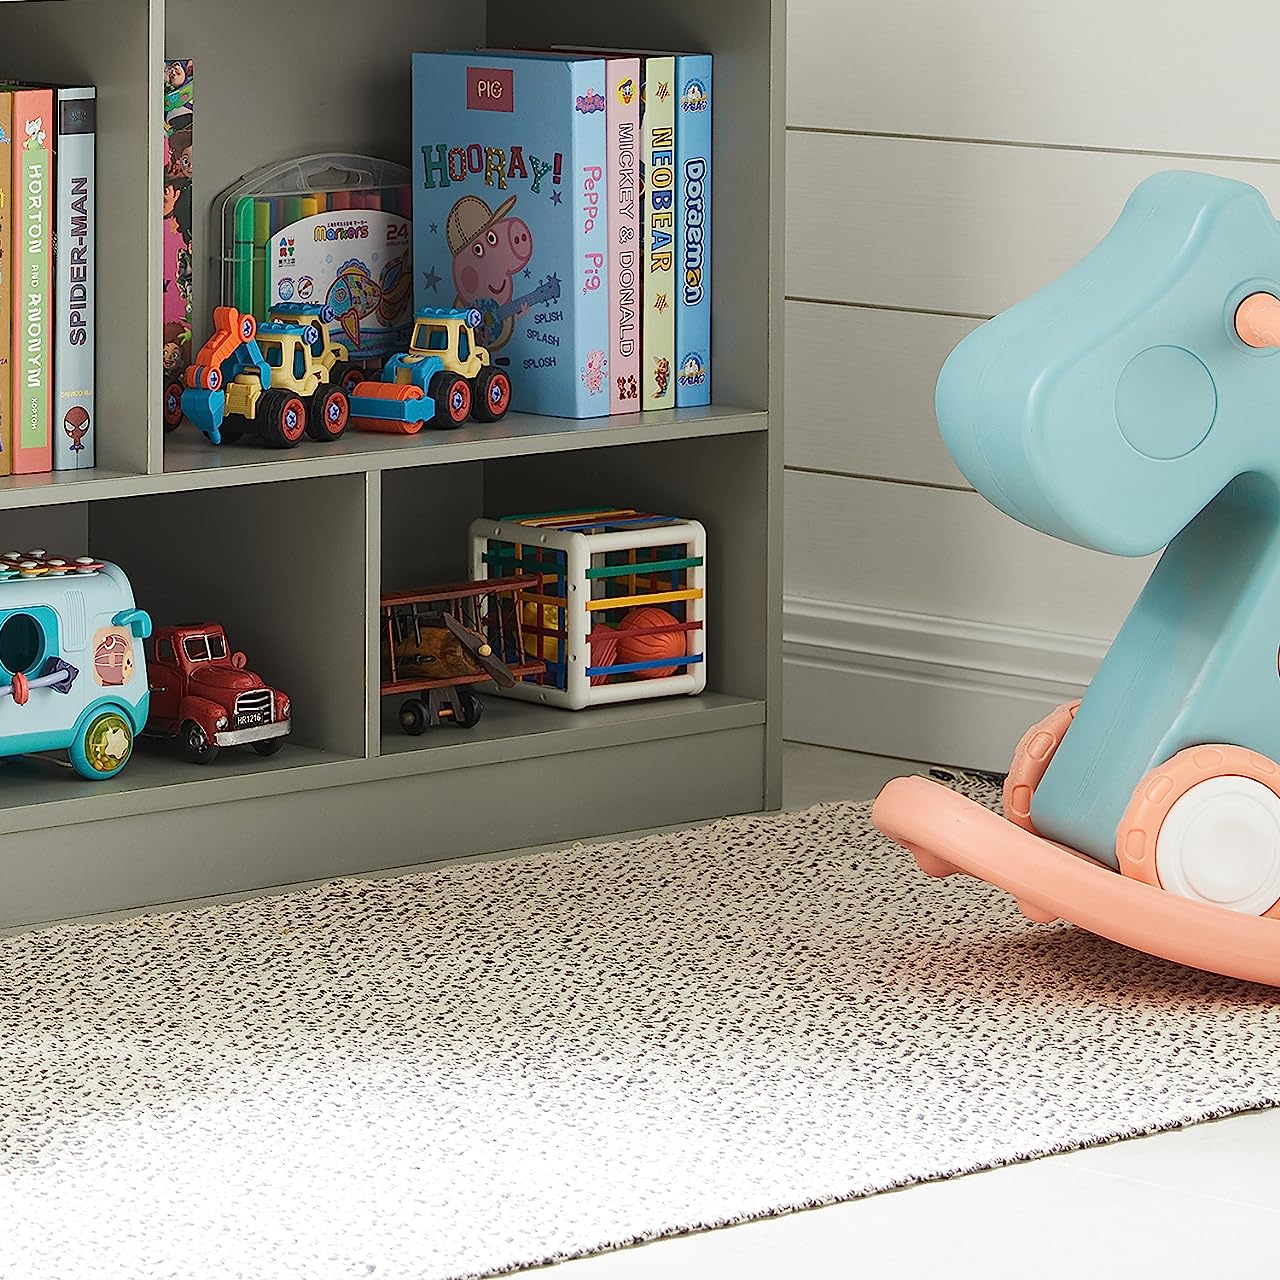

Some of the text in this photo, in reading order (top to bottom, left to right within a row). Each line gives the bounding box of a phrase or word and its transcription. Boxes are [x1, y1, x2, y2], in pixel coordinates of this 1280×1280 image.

[476, 79, 503, 99] PIG
[421, 143, 563, 195] HOORAY!
[27, 164, 43, 254] HORTON
[651, 126, 673, 274] NEOBEAR
[386, 223, 408, 240] 24
[618, 122, 635, 357] MICKEY & DONALD
[683, 156, 707, 306] Doraemon
[69, 176, 89, 347] SPIDER-MAN
[526, 328, 560, 347] SPLASH
[534, 311, 563, 324] SPLISH
[523, 356, 557, 369] SPLOSH
